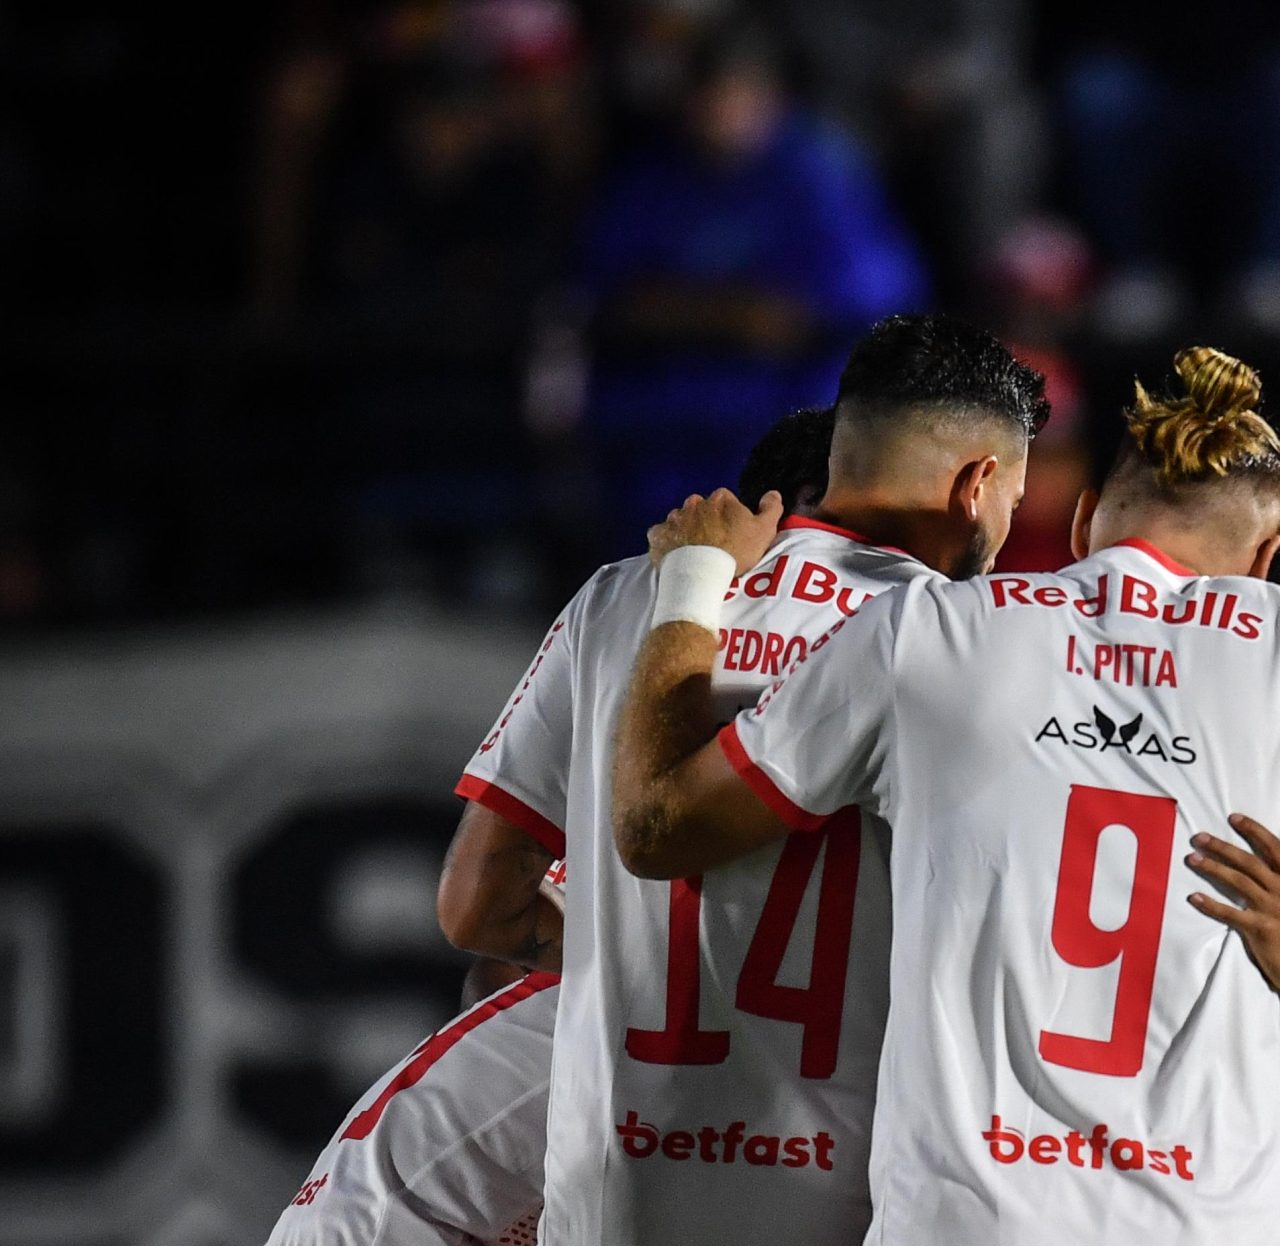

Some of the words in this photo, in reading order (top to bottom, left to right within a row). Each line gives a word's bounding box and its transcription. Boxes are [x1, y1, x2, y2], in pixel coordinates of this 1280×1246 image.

[989, 574, 1109, 618] Red
[1119, 575, 1264, 640] Bulls
[1066, 635, 1084, 676] I.
[1093, 643, 1178, 689] PITTA
[1035, 704, 1197, 765] ASAAS
[624, 805, 862, 1080] 14
[1038, 783, 1178, 1078] 9
[615, 1110, 835, 1172] betfast
[981, 1115, 1194, 1181] betfast
